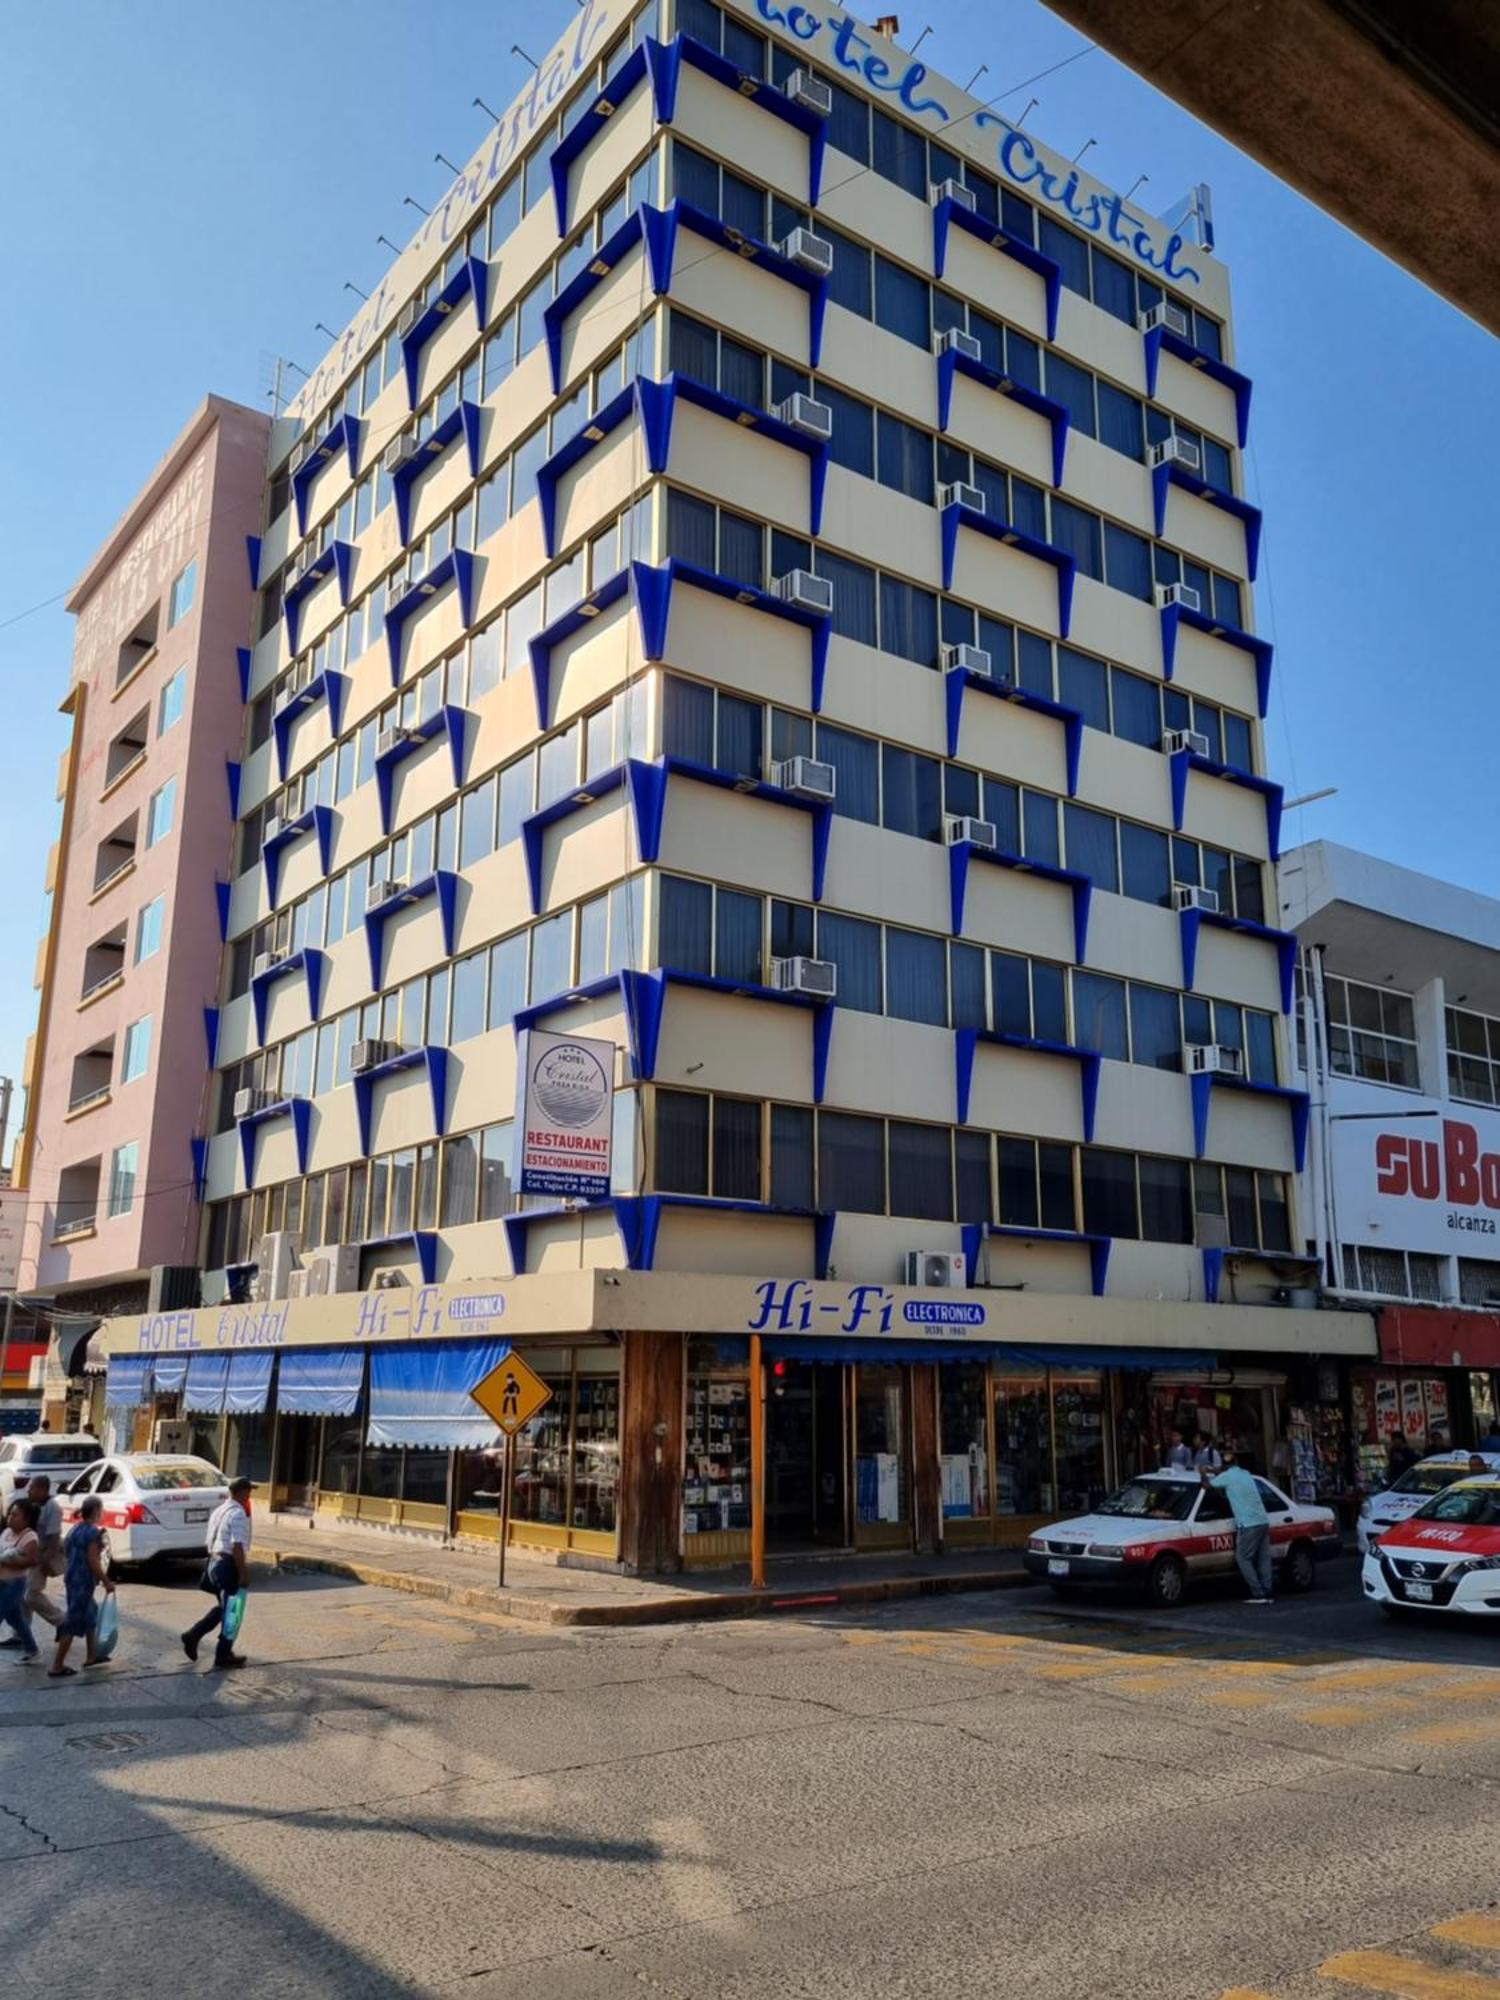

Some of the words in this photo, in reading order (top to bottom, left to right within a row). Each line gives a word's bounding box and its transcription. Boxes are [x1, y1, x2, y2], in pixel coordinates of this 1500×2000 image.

[976, 112, 1199, 284] Cristal
[558, 1054, 585, 1065] HOTEL
[527, 1130, 608, 1152] RESTAURANT
[526, 1153, 607, 1173] ESTACIONAMIENTO
[1447, 1211, 1496, 1234] alcanza
[354, 1287, 443, 1337] Hi-Fi
[748, 1279, 895, 1334] Hi-Fi
[906, 1303, 983, 1323] ELECTRONICA
[139, 1312, 201, 1350] HOTEL
[1210, 1535, 1234, 1551] TAXI
